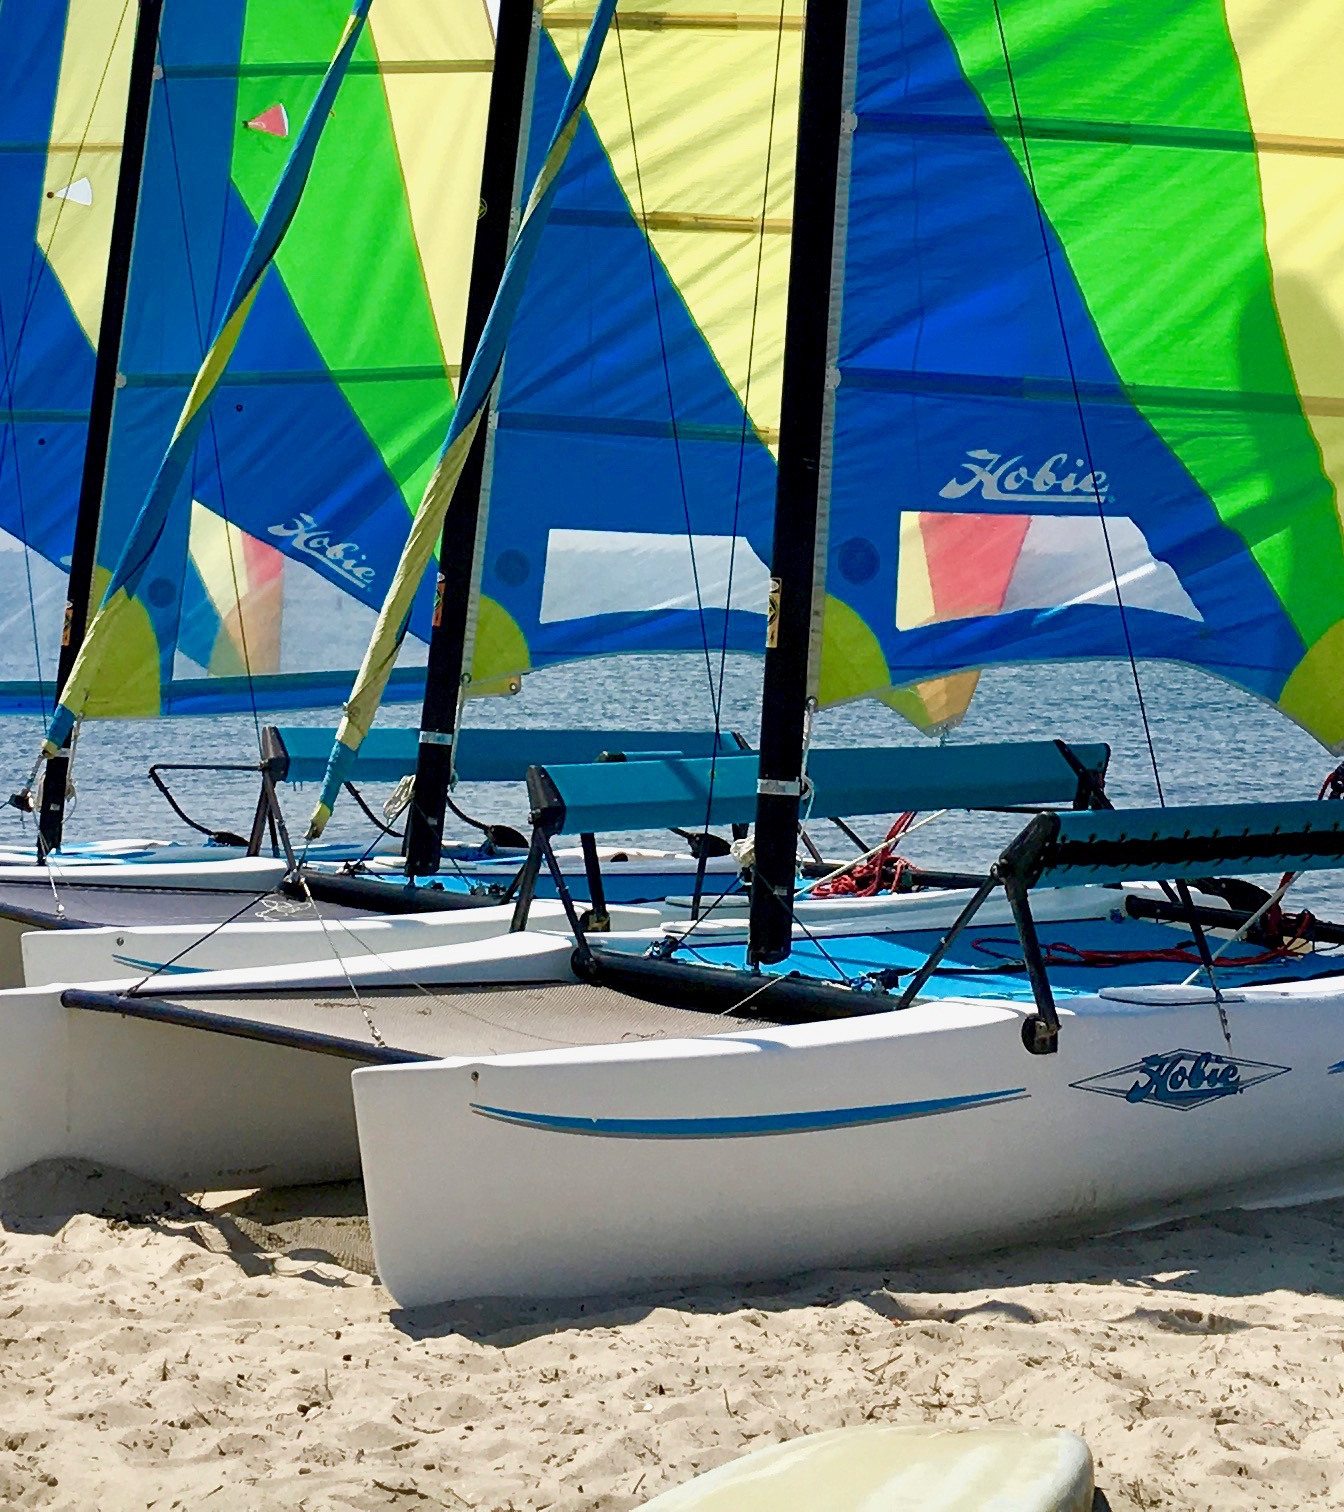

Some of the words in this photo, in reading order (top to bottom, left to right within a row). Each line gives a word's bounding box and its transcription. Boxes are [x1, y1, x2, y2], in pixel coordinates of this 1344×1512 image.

[938, 448, 1110, 503] Hobie
[267, 512, 376, 590] Hobie
[1125, 1051, 1240, 1104] Hobie
